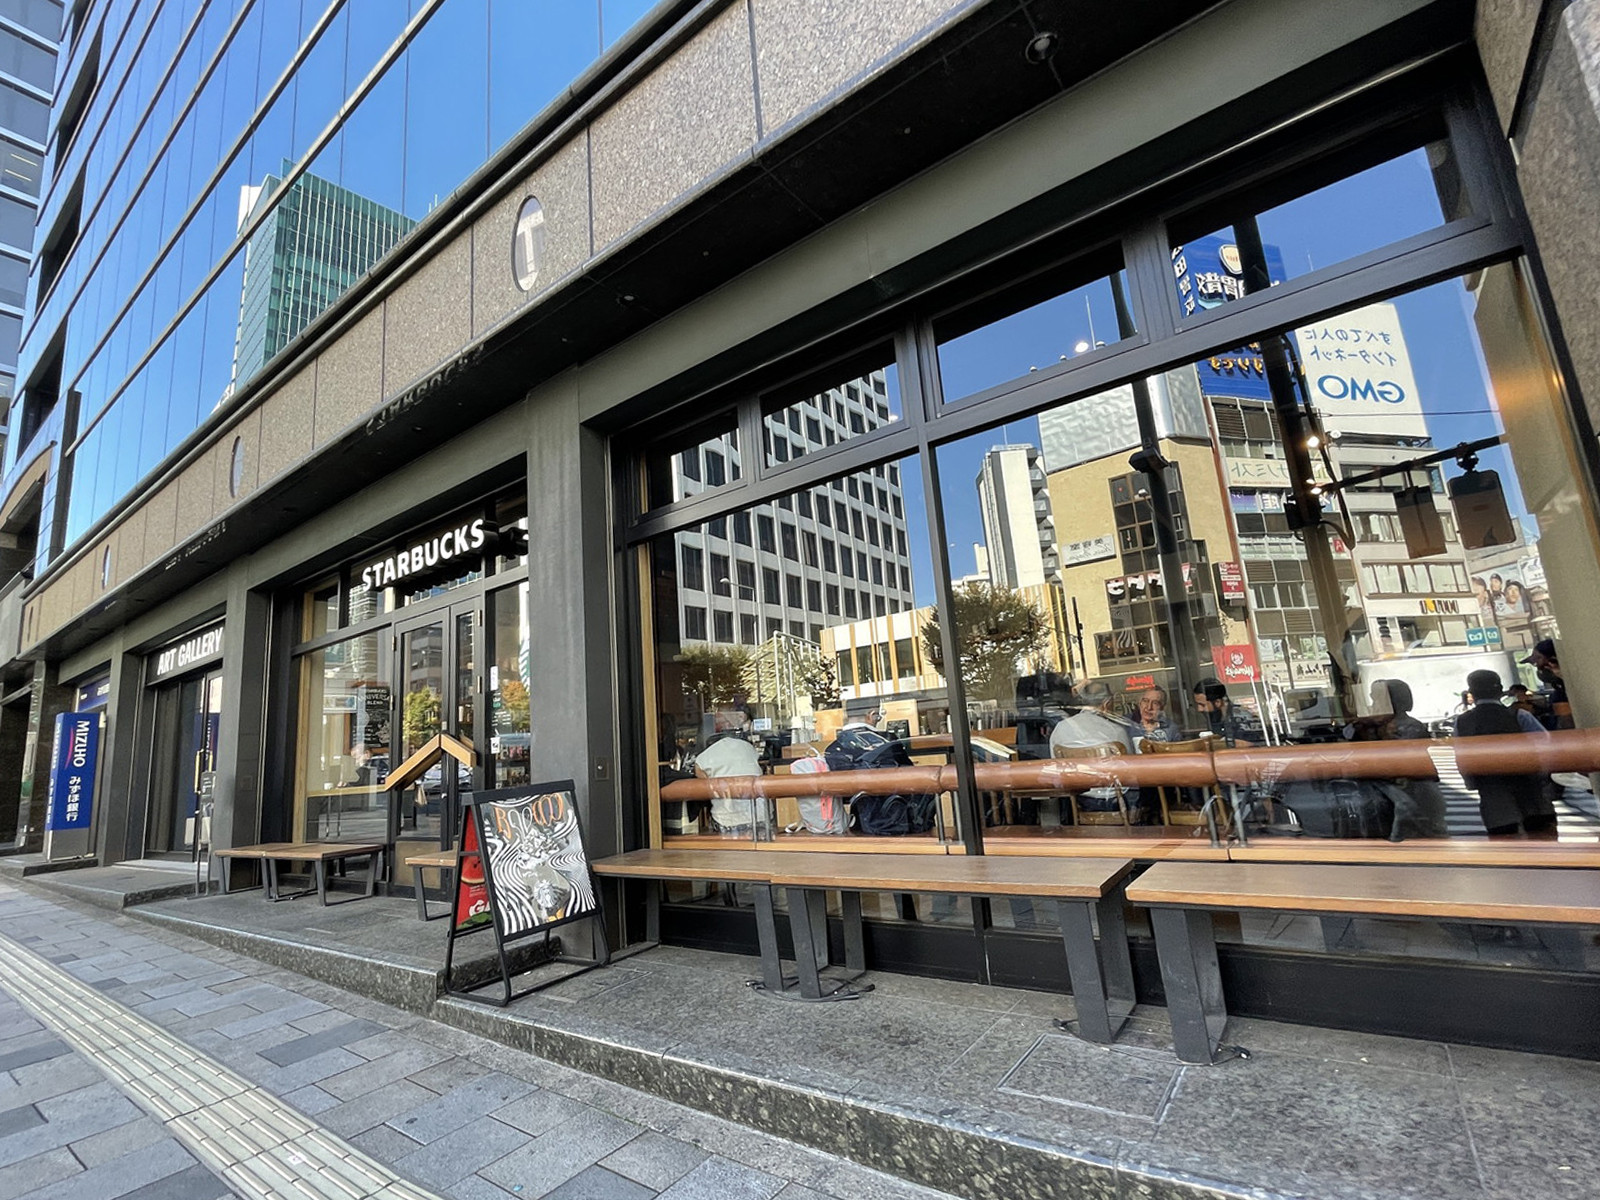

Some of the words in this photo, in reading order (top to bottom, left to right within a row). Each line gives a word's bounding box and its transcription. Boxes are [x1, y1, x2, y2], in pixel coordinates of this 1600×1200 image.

[361, 518, 485, 593] STARBUCKS
[157, 647, 177, 676] ART
[178, 626, 224, 667] GALLERY
[73, 720, 91, 768] MIZUHO
[66, 775, 82, 822] みずほ銀行
